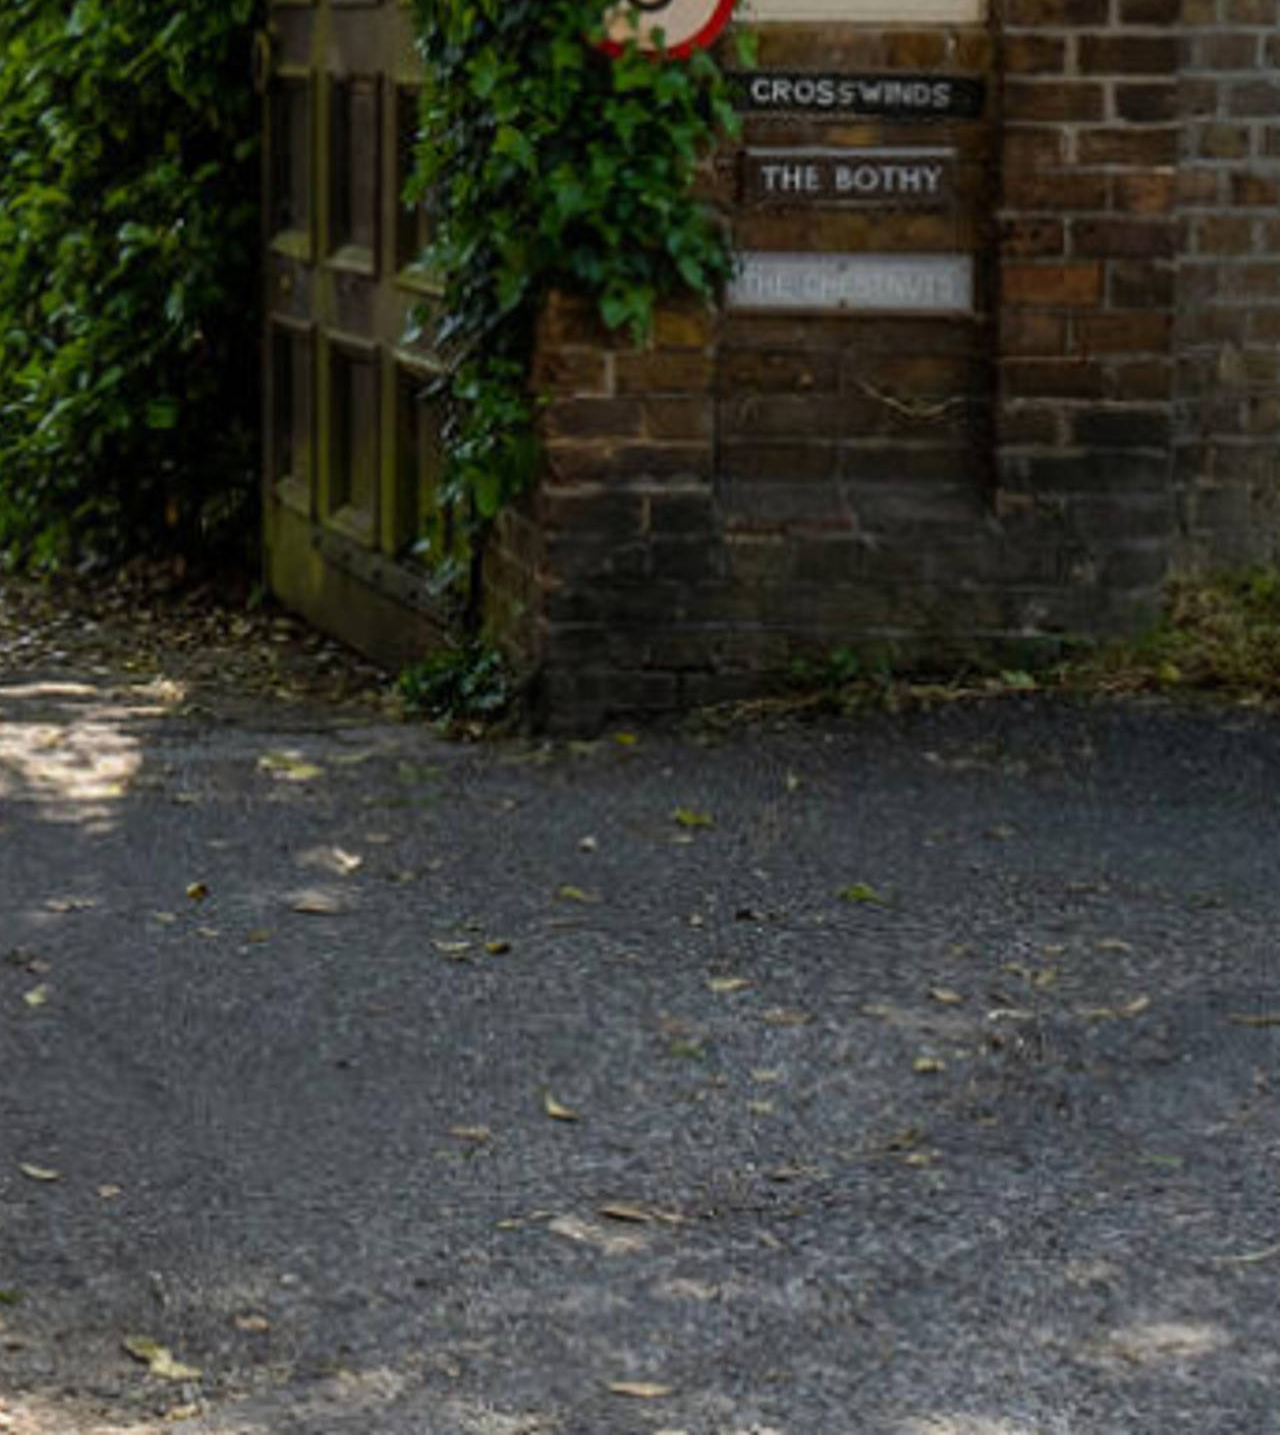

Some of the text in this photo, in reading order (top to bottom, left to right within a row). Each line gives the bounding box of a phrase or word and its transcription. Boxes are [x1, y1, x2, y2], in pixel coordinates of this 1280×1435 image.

[750, 77, 953, 108] CROSSWINDS
[762, 165, 943, 193] THE BOTHY
